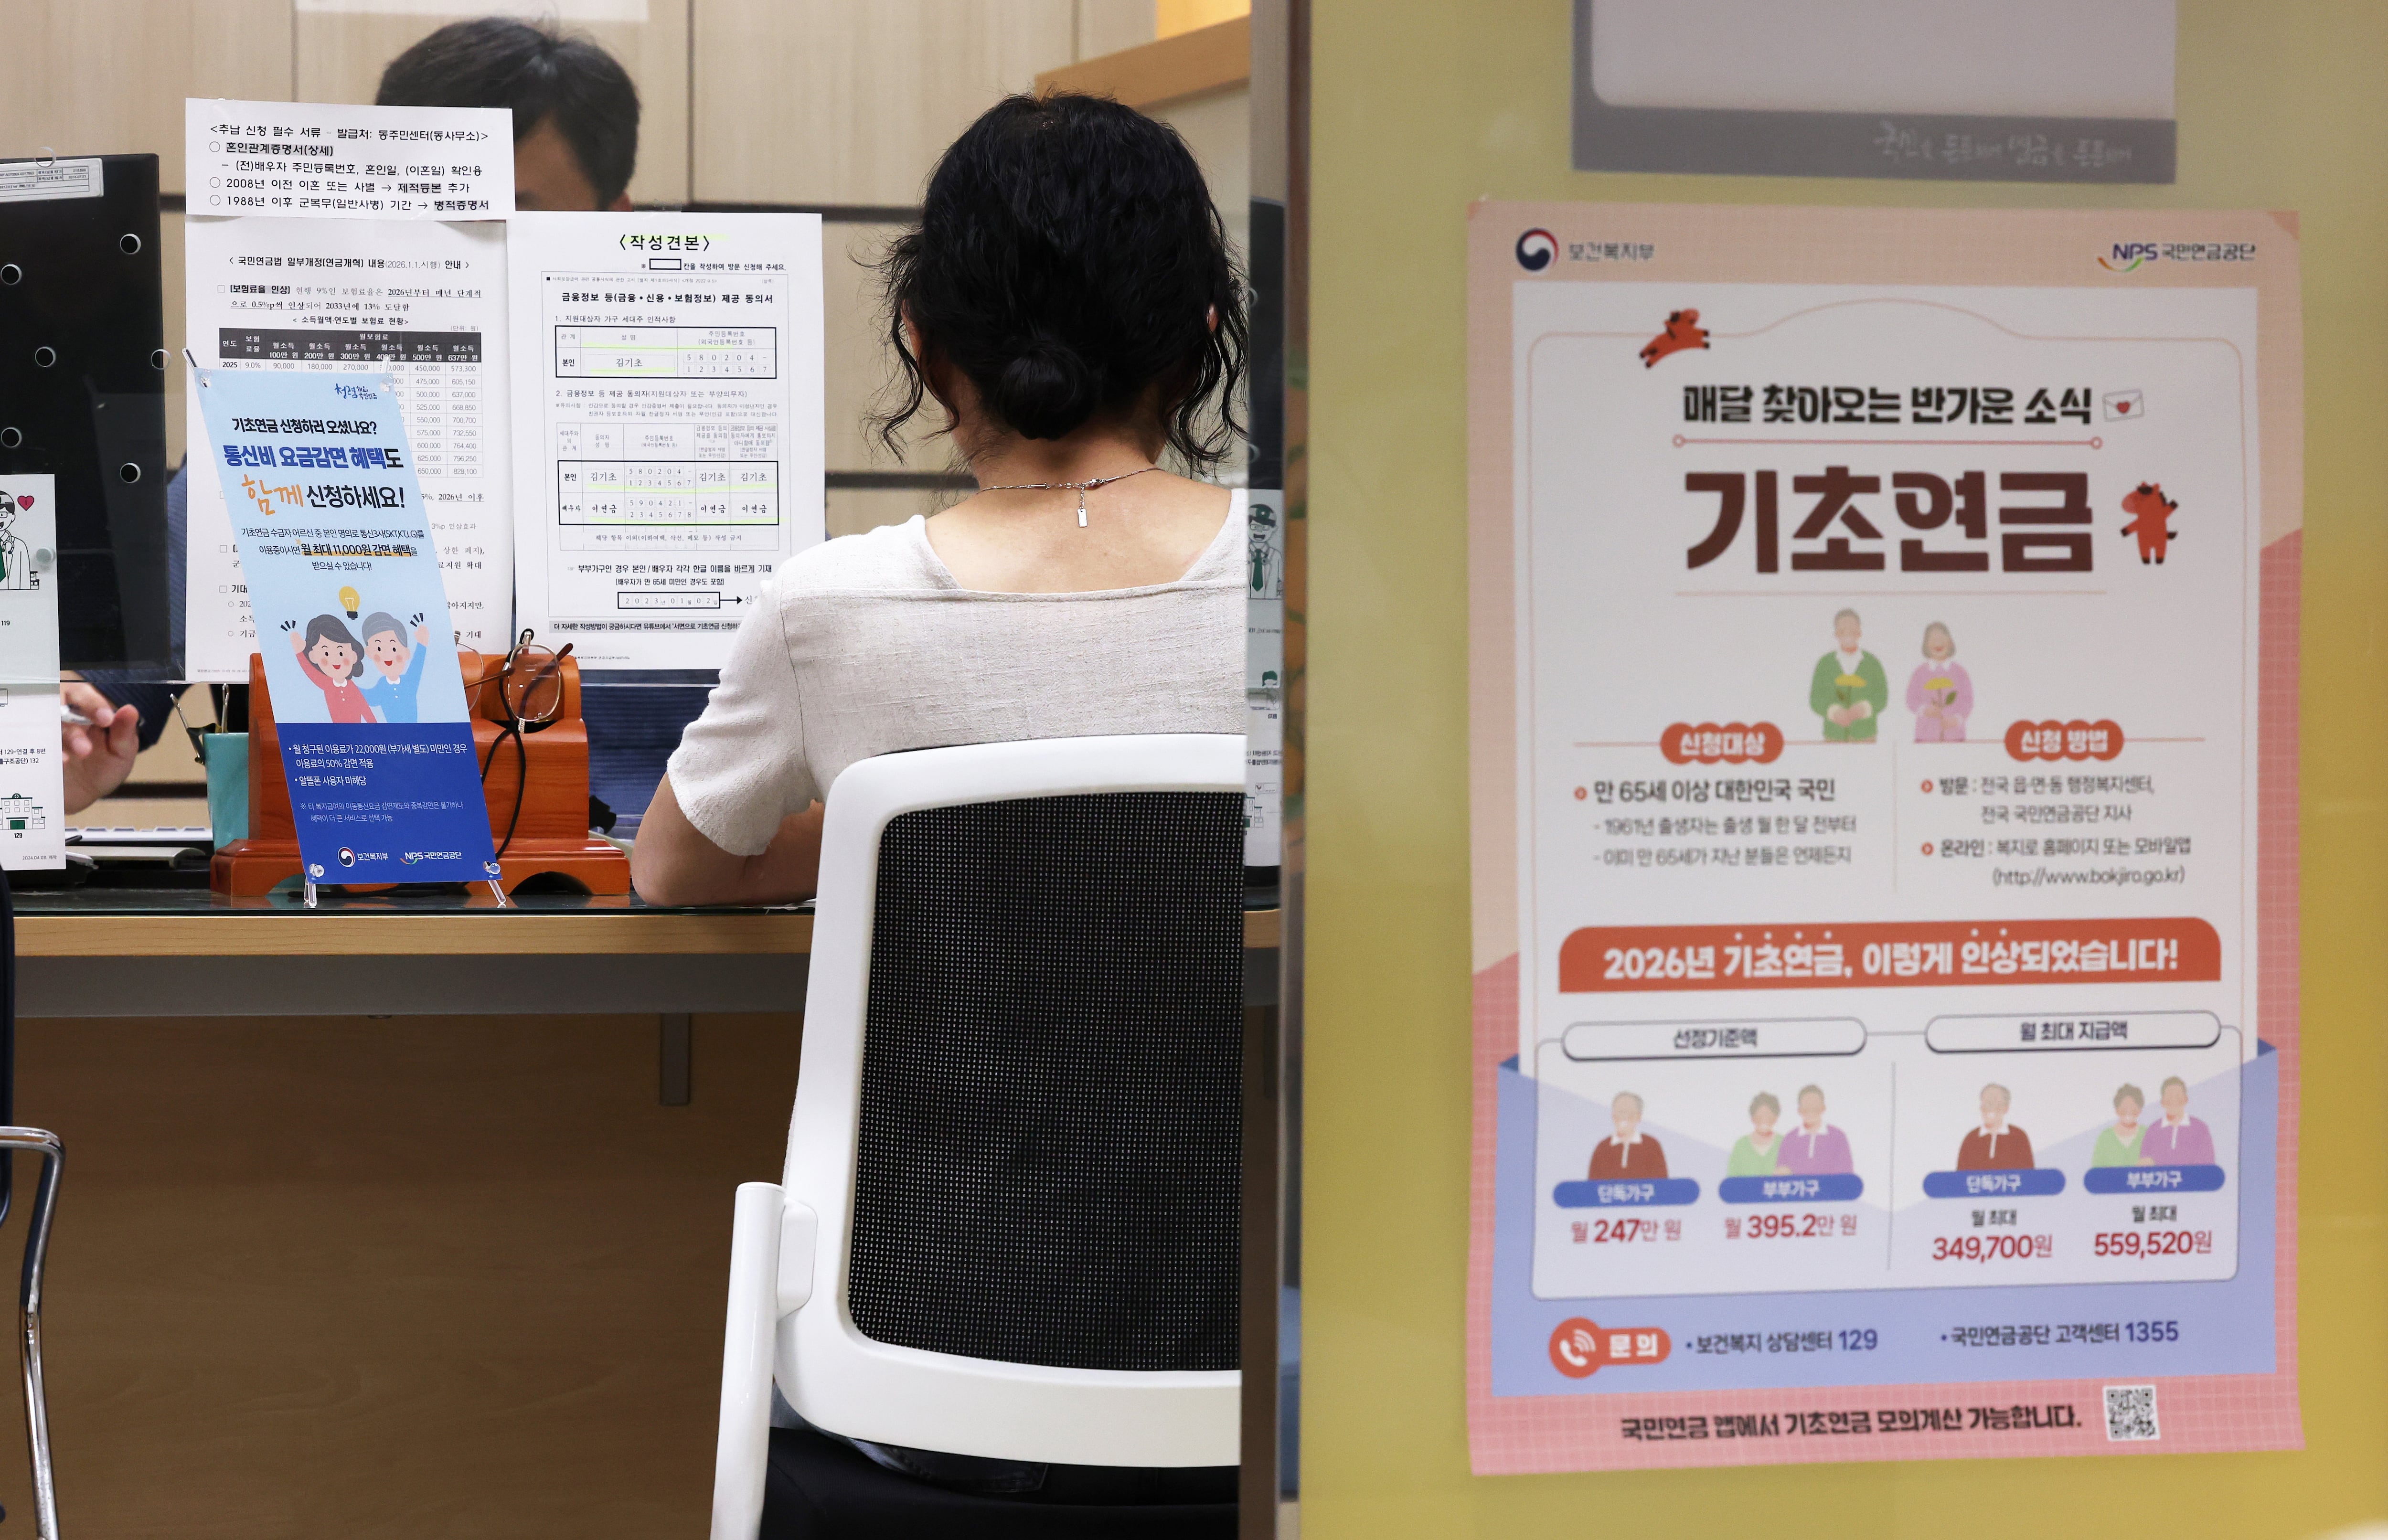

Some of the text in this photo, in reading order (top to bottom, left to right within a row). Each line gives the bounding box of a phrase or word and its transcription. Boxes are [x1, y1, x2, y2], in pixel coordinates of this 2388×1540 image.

[211, 124, 488, 141] <추납 신청 필수 서류 발급처: 동주민센터(동사무소)>
[227, 142, 332, 156] 혼인관계증명서(상세)
[236, 160, 482, 176] (전)배우자 주민등록번호, 혼인일, (이혼일) 확인용
[227, 179, 469, 193] 2008년 이전 이혼 또는 사별 제적등본 추가
[228, 197, 488, 211] 1988년 이후 군복무(일반사병) 기간 병적증명서
[2113, 244, 2256, 261] NPS 국민연금공단
[1684, 384, 2091, 425] 매달 찾아오는 반가운 소식
[232, 418, 376, 435] 기초연금 신청하러 오셨나요?
[223, 446, 404, 469] 통신비 요금감면 혜택도
[242, 474, 405, 515] 함께 신청하세요!
[1685, 466, 2092, 573] 기초연금
[242, 528, 424, 538] 기초연금 수급자 어르신 중 본인 명의로 통신3사(SKT,KT,LG)를
[259, 544, 417, 556] 이용중이시면 월 최대 11,000원 감면 혜택을
[312, 562, 371, 571] 받으실 수 있습니다!
[735, 565, 754, 573] 바르게
[293, 743, 467, 754] 월 청구된 이용료가 22,000원 (부가세 별도) 미만인 경우
[1681, 732, 1765, 756] 신청대상
[2022, 730, 2108, 753] 신청 방법
[296, 759, 373, 768] 이용료의 50% 감면 적용
[299, 775, 366, 786] 알뜰폰 사용자 미해당
[1595, 779, 1834, 803] 만 65세 이상 대한민국 국민
[405, 852, 423, 861] NPS
[1604, 939, 2177, 979] 2026년 기초연금, 이렇게 인상되었습니다!
[2021, 1021, 2127, 1041] 월 최대 지급액
[1764, 1180, 1819, 1197] 부부가구
[1967, 1175, 2021, 1193] 단독가구
[2127, 1171, 2182, 1188] 부부가구
[1598, 1184, 1654, 1203] 단독가구
[1572, 1219, 1681, 1243] 월 247만 원
[1725, 1214, 1856, 1239] 월 395.2만 원
[1933, 1235, 2051, 1263] 349,700원
[2095, 1231, 2211, 1259] 559,520원
[1697, 1329, 1877, 1354] 보건복지 상담센터 129
[1951, 1321, 2178, 1346] 국민연금공단 고객센터 1355
[1621, 1405, 2081, 1440] 국민연금 앱에서 기초연금 모의계산 가능합니다.
